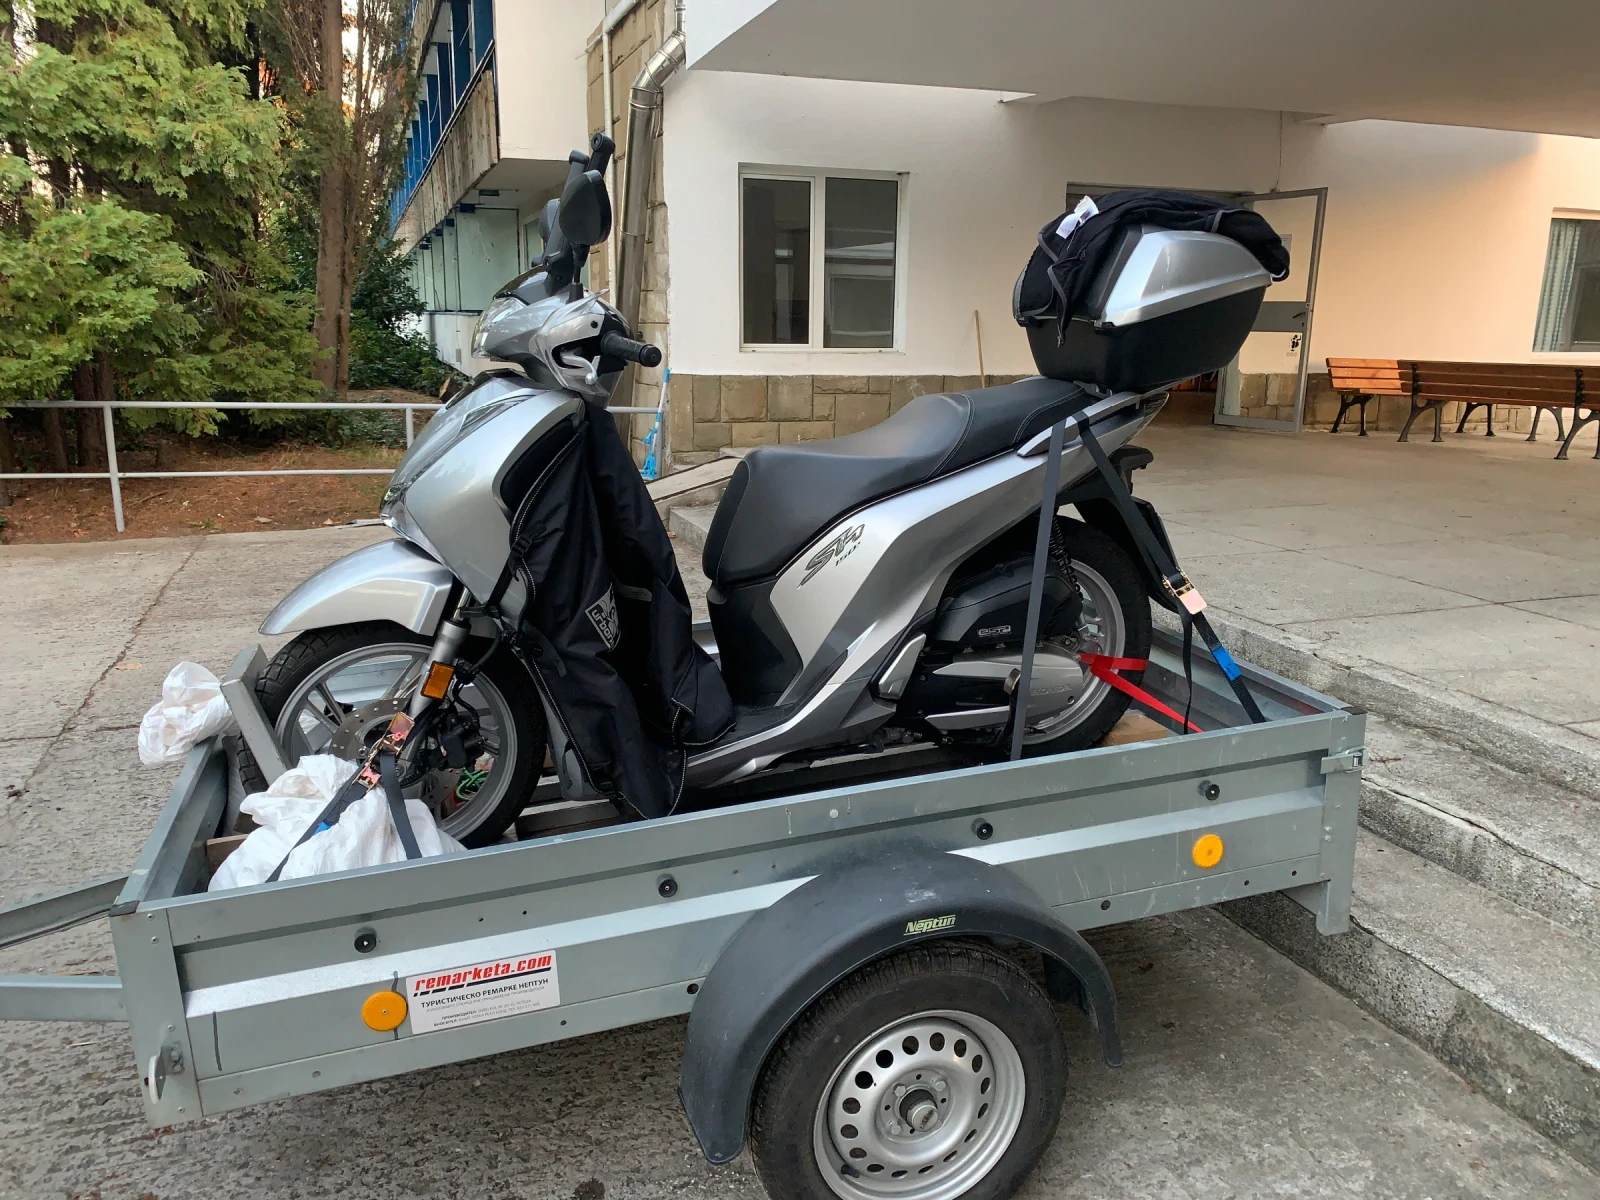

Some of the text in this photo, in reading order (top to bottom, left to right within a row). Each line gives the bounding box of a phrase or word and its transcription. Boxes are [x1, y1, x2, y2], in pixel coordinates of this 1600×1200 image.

[905, 916, 957, 933] Neptun
[415, 955, 552, 991] remarketa.com
[421, 991, 481, 1008] ТУРИСТИЧЕСКО
[483, 984, 517, 997] РЕМАРКЕ
[518, 978, 549, 989] НЕПТУН
